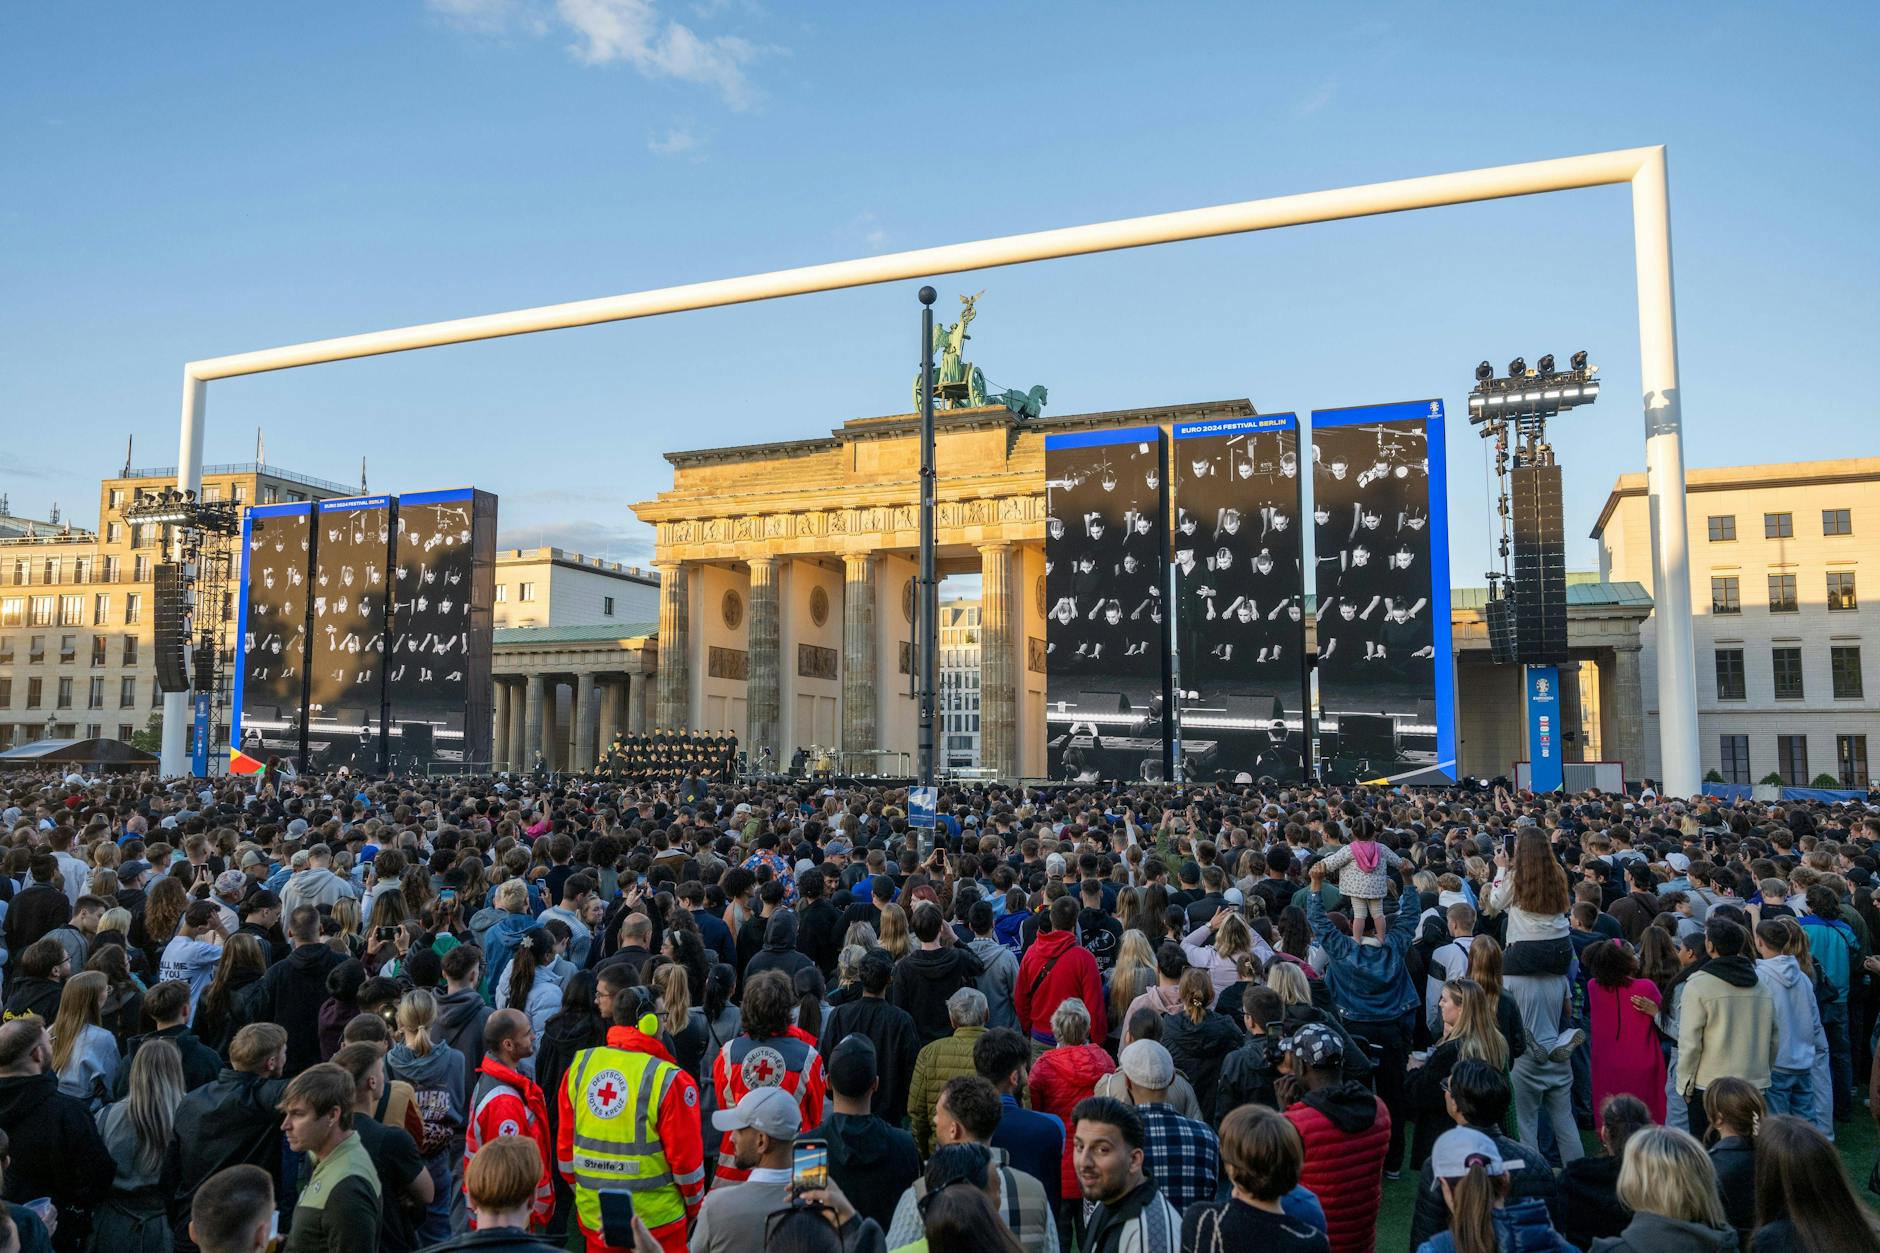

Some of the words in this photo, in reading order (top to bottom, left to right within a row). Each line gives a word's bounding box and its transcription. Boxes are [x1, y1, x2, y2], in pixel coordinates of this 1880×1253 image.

[1181, 426, 1202, 434] EURO
[1203, 424, 1222, 432] 2024
[1223, 422, 1258, 430] FESTIVAL
[1259, 419, 1287, 427] BERLIN
[164, 970, 180, 978] YOU
[173, 962, 187, 970] ME
[748, 1050, 783, 1069] DEUTSCHES
[593, 1071, 627, 1092] DEUTSCHES
[589, 1092, 603, 1116] ROTES
[605, 1098, 625, 1117] KREUZ
[584, 1159, 615, 1171] Streife
[617, 1162, 624, 1171] 3
